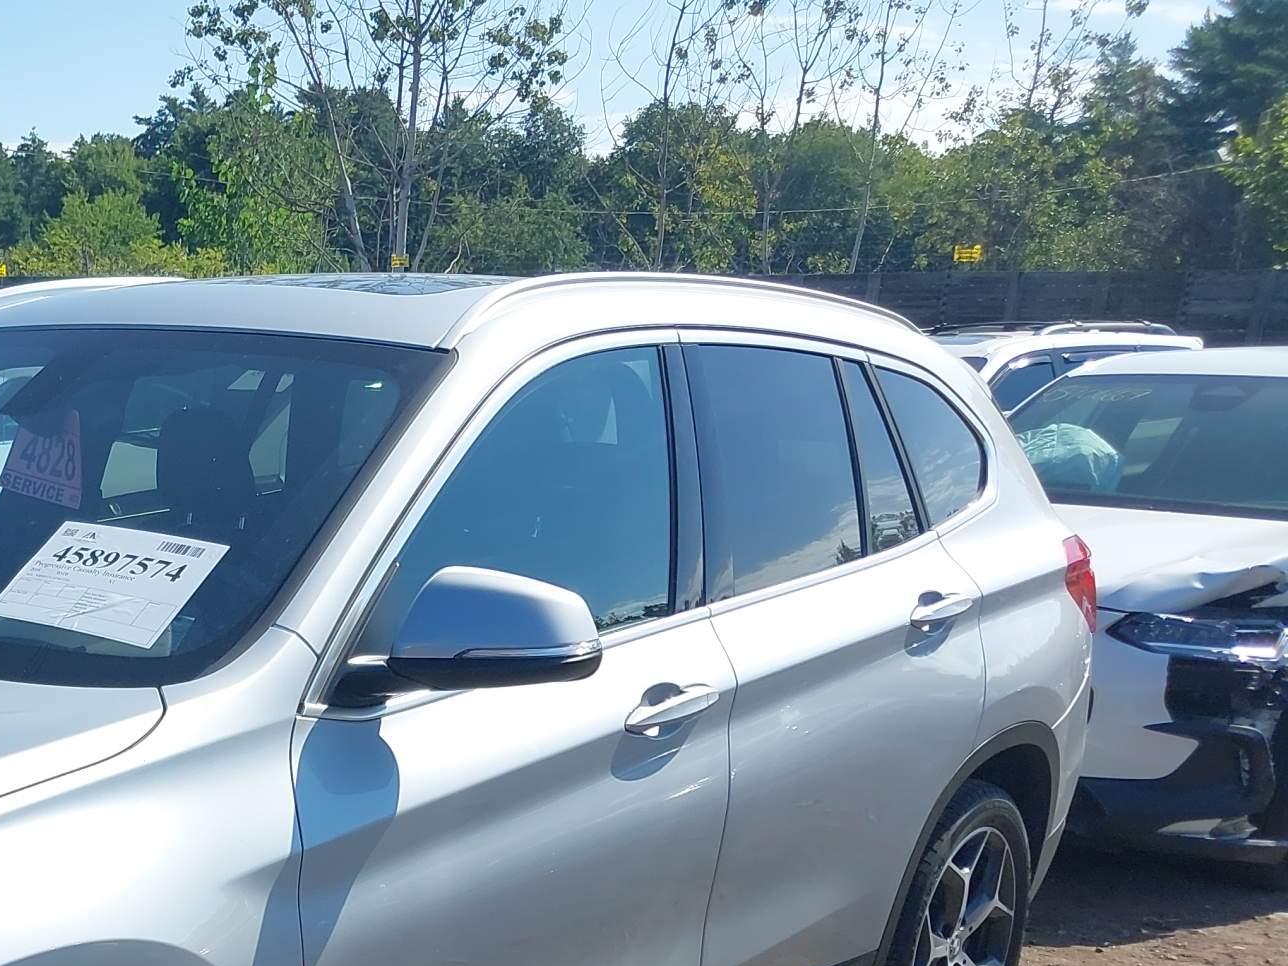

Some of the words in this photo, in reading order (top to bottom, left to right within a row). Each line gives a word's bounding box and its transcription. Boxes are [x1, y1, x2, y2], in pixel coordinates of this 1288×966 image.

[20, 435, 76, 481] 4828
[0, 471, 65, 502] SERVICE
[34, 560, 73, 571] Progressive
[73, 566, 101, 577] Casualty
[102, 569, 136, 581] Insurance
[52, 544, 188, 583] 45897574
